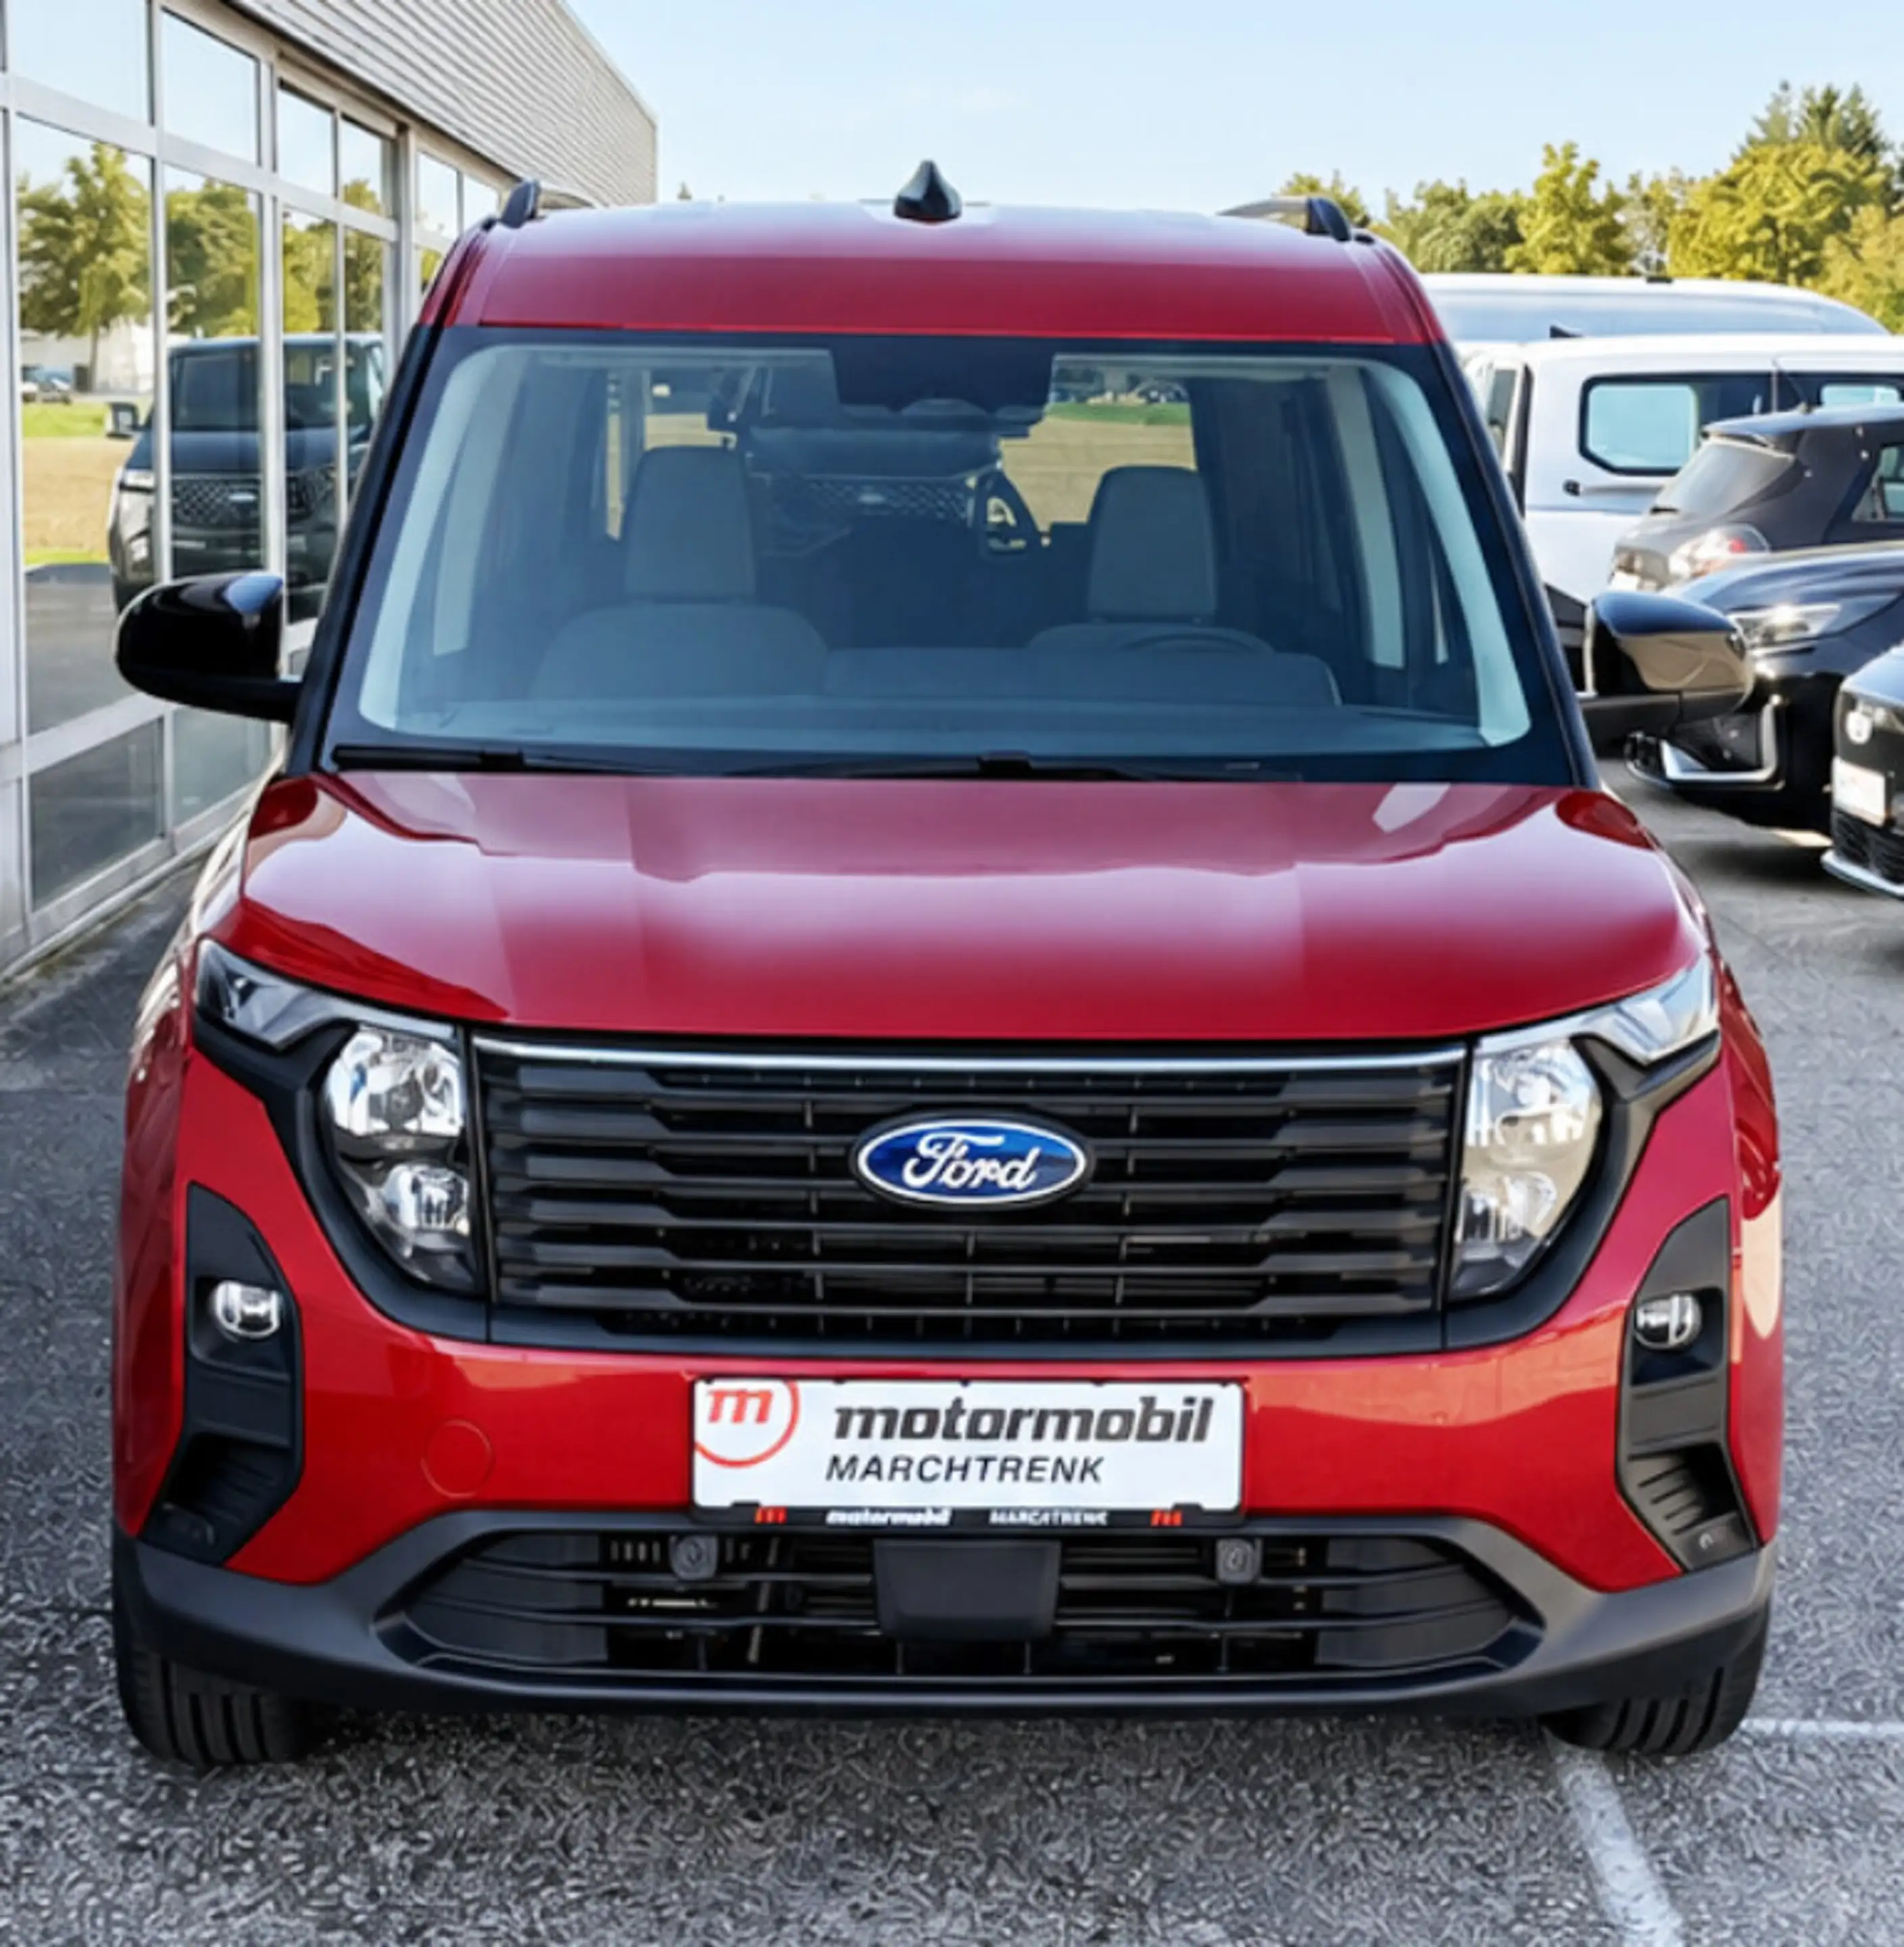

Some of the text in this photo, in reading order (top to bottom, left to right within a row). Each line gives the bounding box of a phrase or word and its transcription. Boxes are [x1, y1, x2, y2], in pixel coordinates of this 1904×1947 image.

[902, 1131, 1041, 1190] Ford
[707, 1388, 774, 1424] m
[834, 1395, 1214, 1443] motormobil
[825, 1453, 1104, 1483] MARCHTRENK
